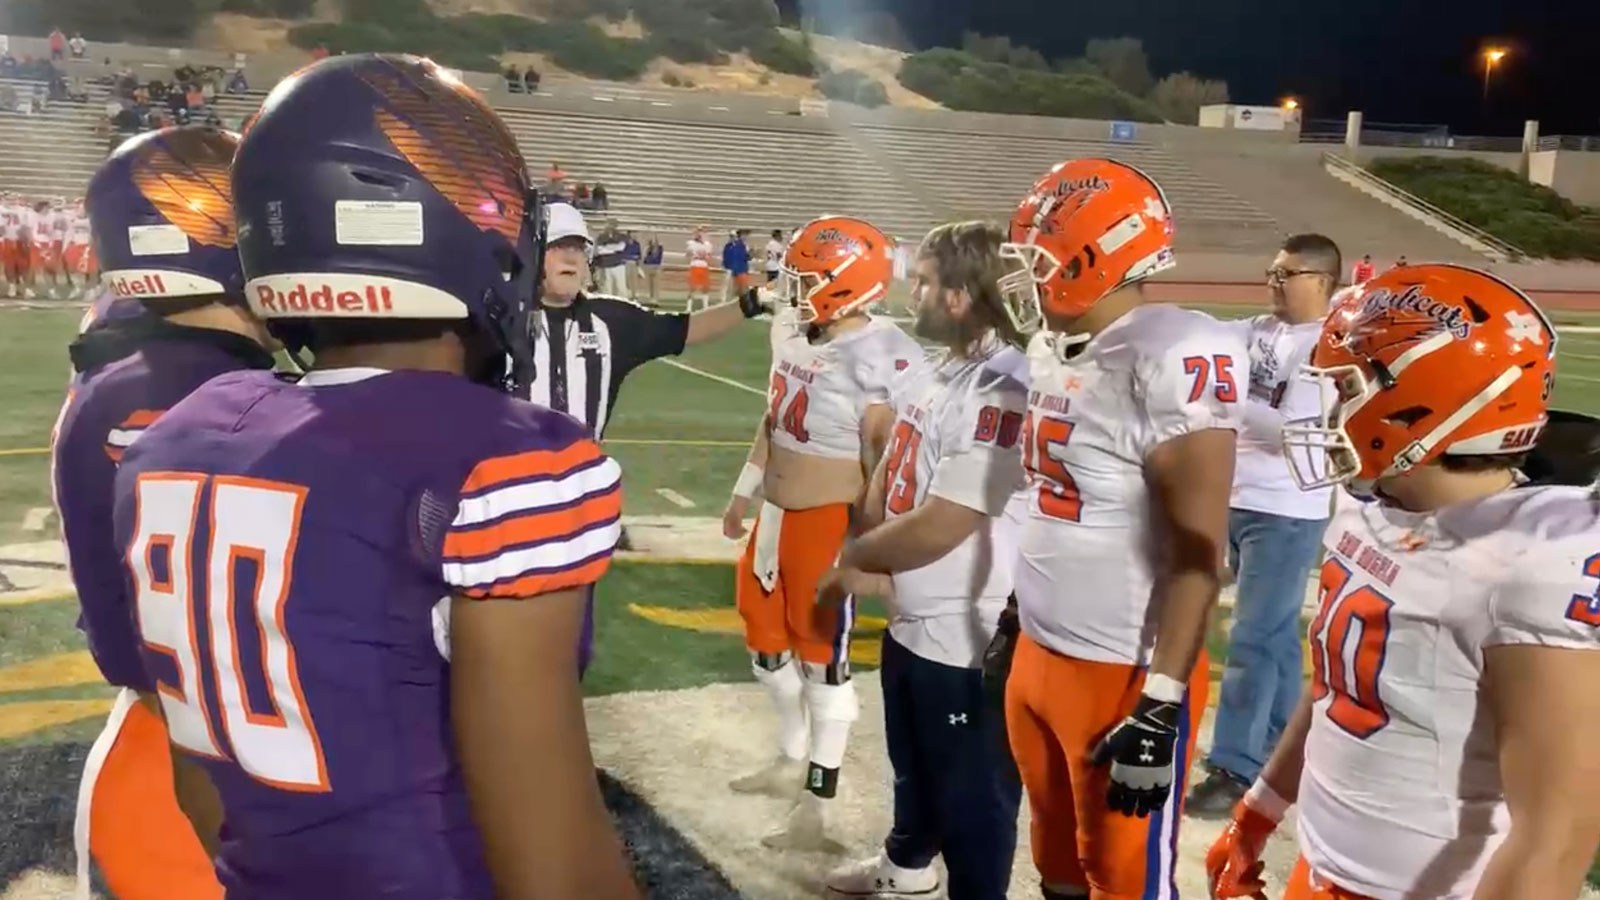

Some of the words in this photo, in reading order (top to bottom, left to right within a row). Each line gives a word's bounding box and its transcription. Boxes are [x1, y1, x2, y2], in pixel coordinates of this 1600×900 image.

[256, 283, 393, 313] Riddell
[1183, 354, 1238, 403] 75
[1499, 426, 1537, 449] SAN
[126, 470, 332, 791] 90
